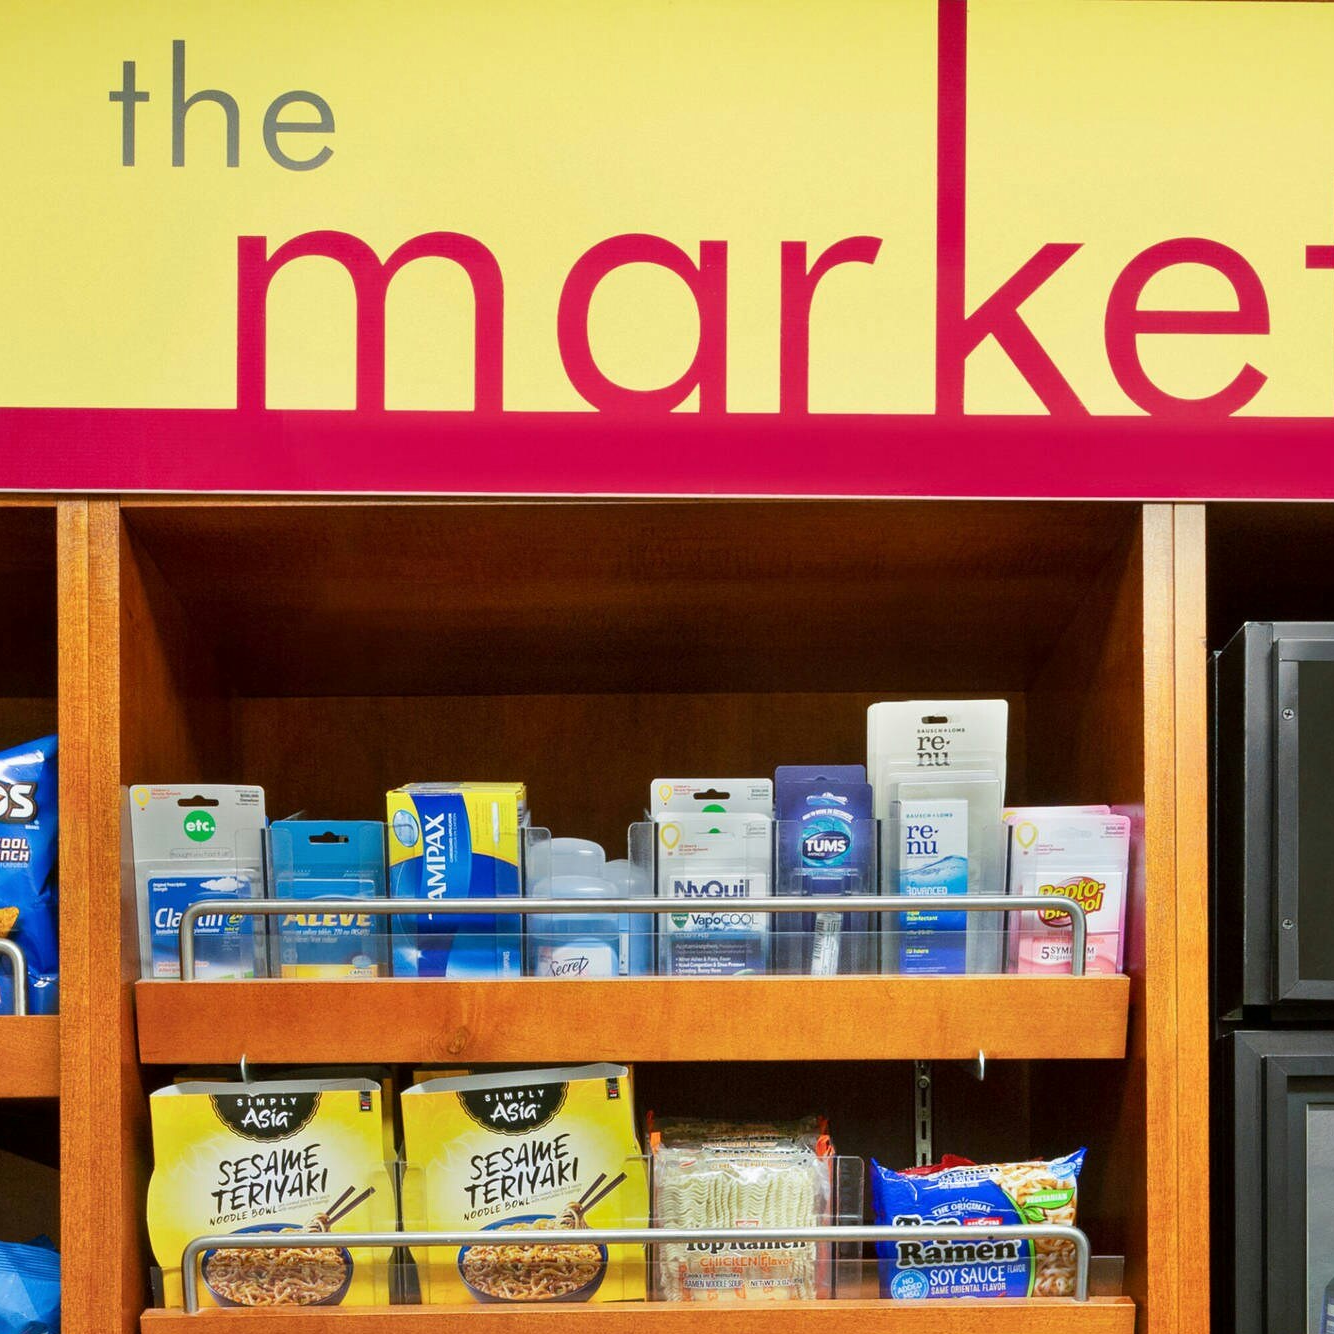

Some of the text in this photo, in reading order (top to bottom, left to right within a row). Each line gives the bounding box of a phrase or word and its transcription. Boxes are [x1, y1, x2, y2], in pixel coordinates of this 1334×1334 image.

[109, 40, 336, 171] the
[186, 819, 216, 832] etc.
[805, 839, 846, 852] TUMS
[425, 813, 446, 920] AMPAX
[155, 907, 223, 928] Clatin
[236, 1097, 298, 1107] SIMPLY
[485, 1088, 545, 1103] SIMPLY
[241, 1106, 289, 1129] Asia
[490, 1103, 538, 1126] Asia
[218, 1144, 321, 1187] SESAME
[465, 1133, 569, 1180] SESAME
[211, 1168, 328, 1213] TERIYAKI
[464, 1157, 578, 1207] TERIYAKI
[209, 1205, 278, 1226] NOODLE BOWL
[463, 1199, 533, 1221] NOODLE BOWL
[932, 1201, 991, 1218] THE ORIGINAL
[700, 1256, 794, 1267] CHICKEN Flavor
[897, 1240, 1018, 1268] Ramen
[929, 1269, 959, 1286] SOY
[961, 1265, 1006, 1283] SAUCE
[931, 1282, 1006, 1295] SAME ORIENTAL FLAVOR
